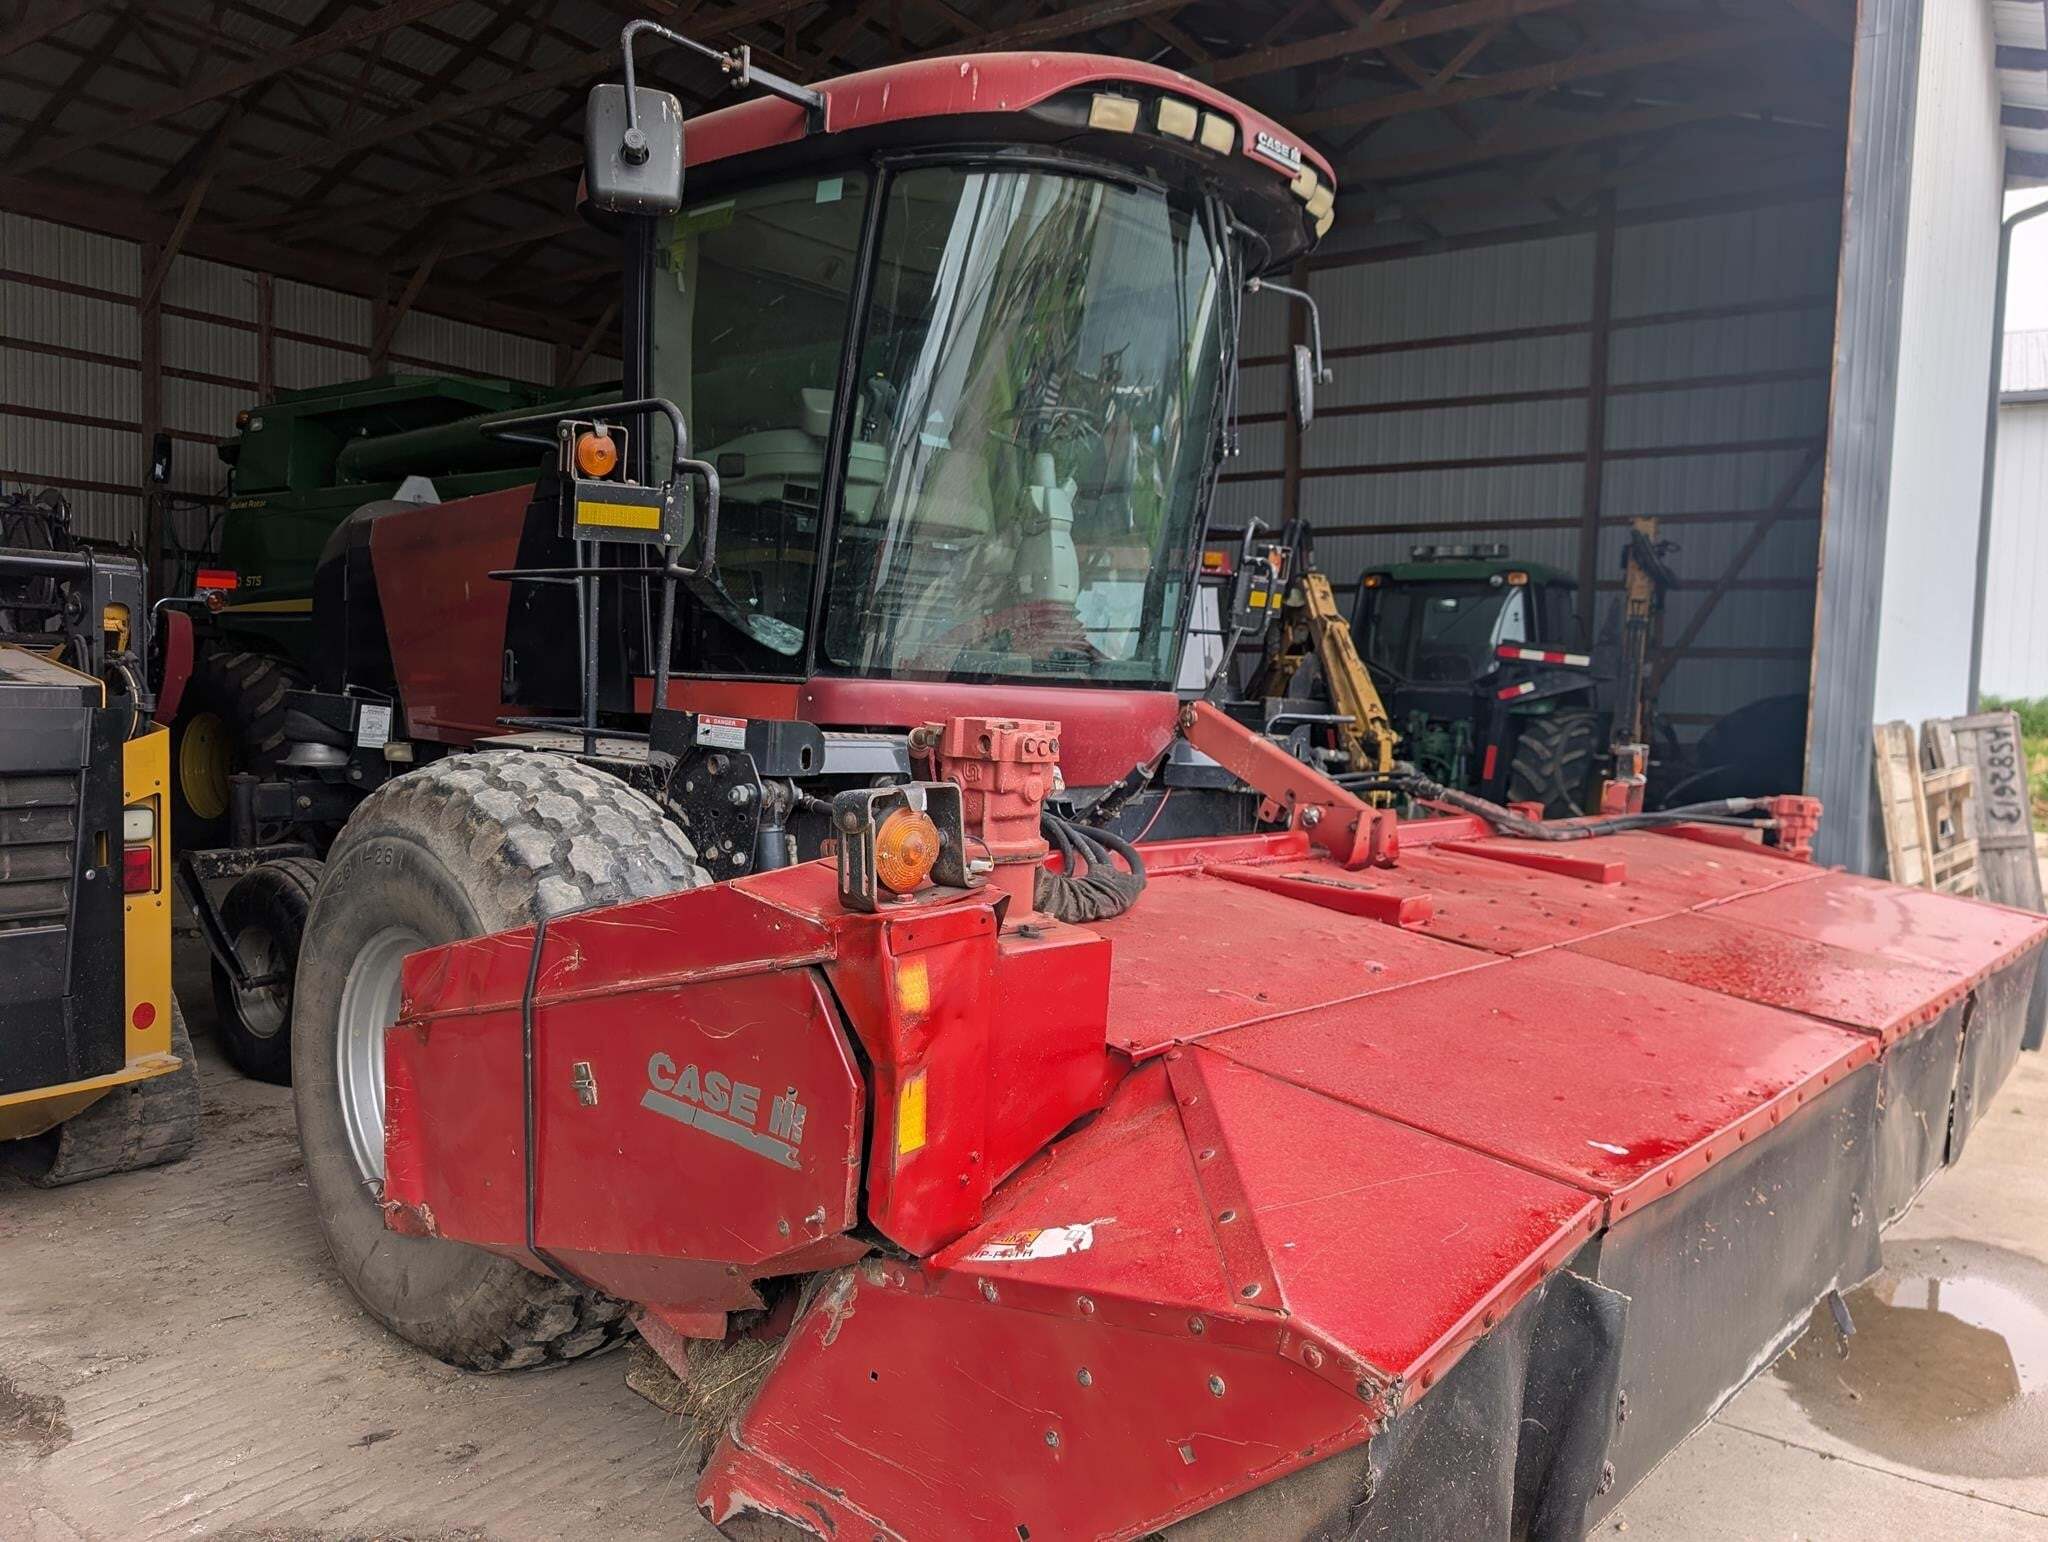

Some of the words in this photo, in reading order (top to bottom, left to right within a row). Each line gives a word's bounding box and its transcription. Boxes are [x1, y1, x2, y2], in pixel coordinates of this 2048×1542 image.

[1258, 132, 1290, 159] CASE
[713, 718, 736, 726] DANGER
[648, 1052, 761, 1126] CASE
